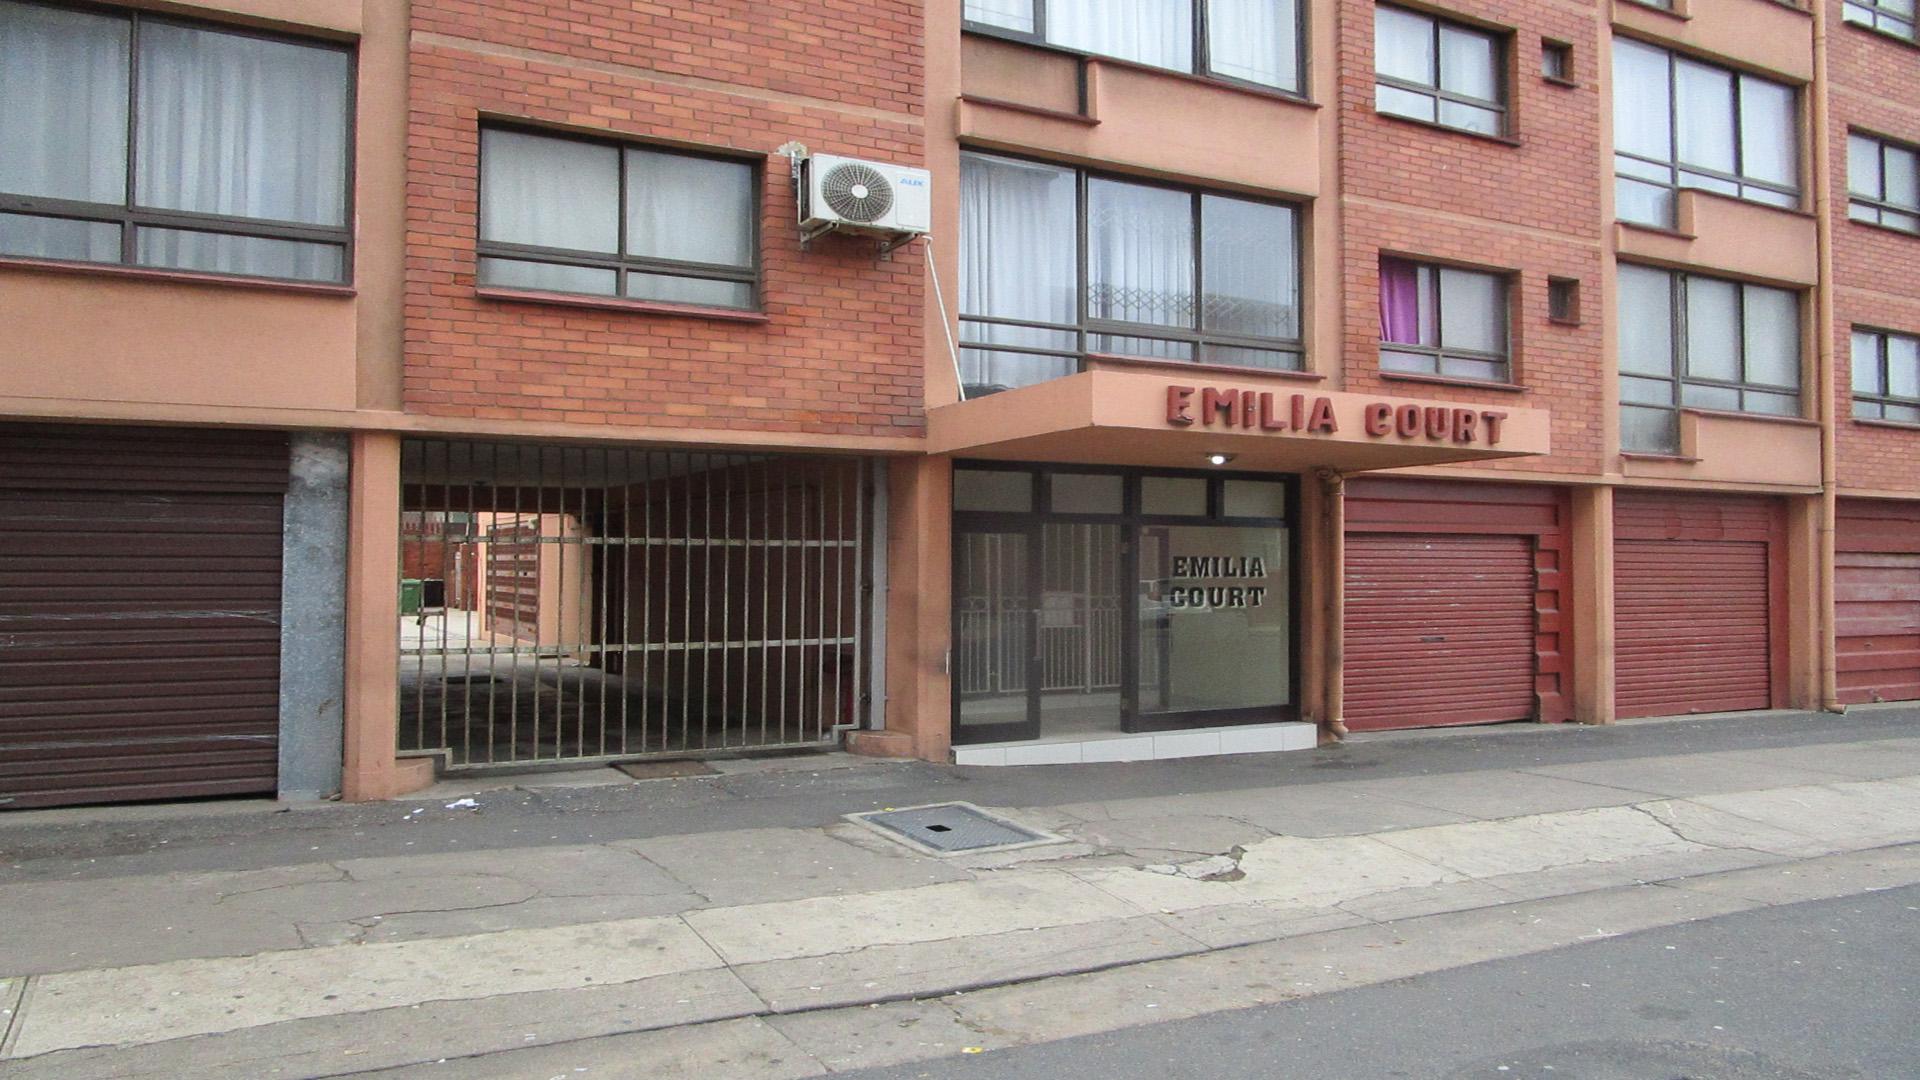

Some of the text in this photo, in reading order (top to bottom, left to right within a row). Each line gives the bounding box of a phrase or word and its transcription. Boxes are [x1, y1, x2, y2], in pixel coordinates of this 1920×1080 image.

[1166, 385, 1508, 445] EMILIA COURT
[1172, 556, 1266, 578] EMILIA
[1170, 586, 1266, 608] COURT
